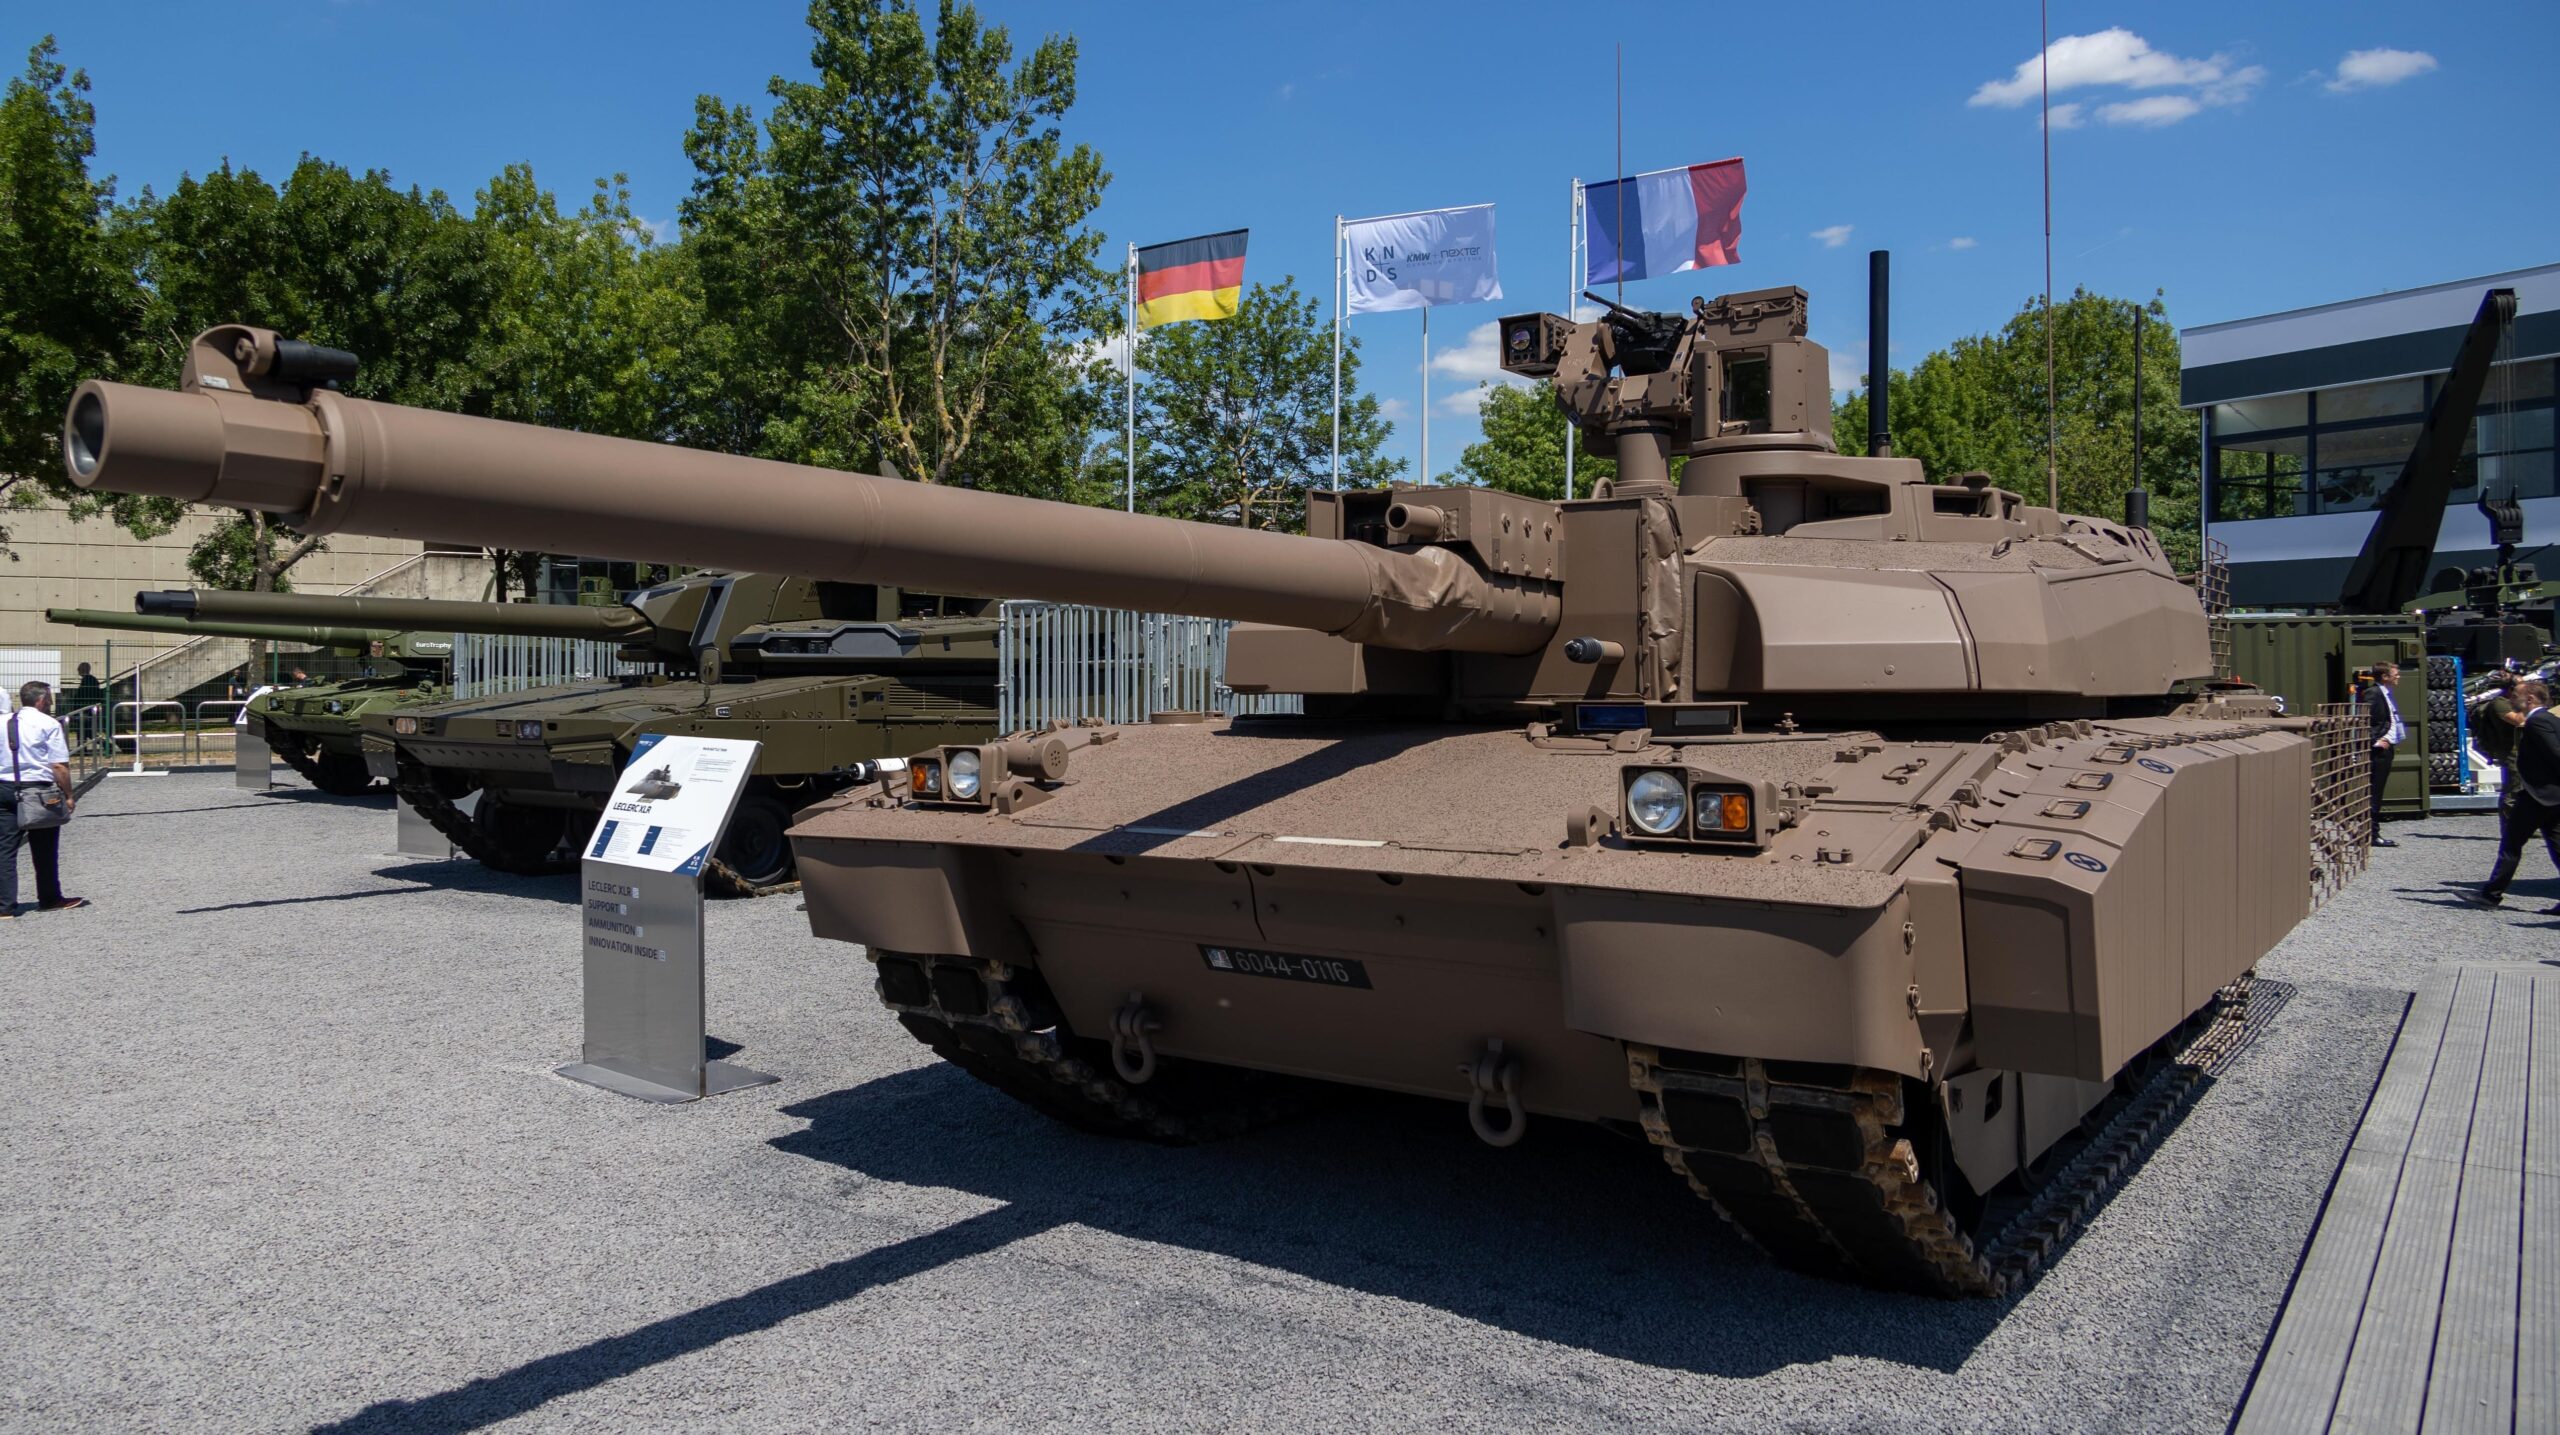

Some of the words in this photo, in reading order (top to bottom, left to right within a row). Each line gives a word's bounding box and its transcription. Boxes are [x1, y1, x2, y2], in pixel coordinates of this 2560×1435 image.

[1406, 252, 1431, 263] KMW
[415, 641, 452, 649] EuroTrophy
[613, 802, 639, 812] LECLERC
[639, 805, 652, 814] XLR
[588, 880, 617, 895] LECLERC
[618, 885, 632, 897] XLR
[588, 898, 619, 913] SUPPORT
[588, 917, 636, 936] AMMUNITION
[588, 935, 633, 954] INNOVATION
[634, 946, 658, 960] INSIDE
[1234, 951, 1350, 983] 6044-0116
